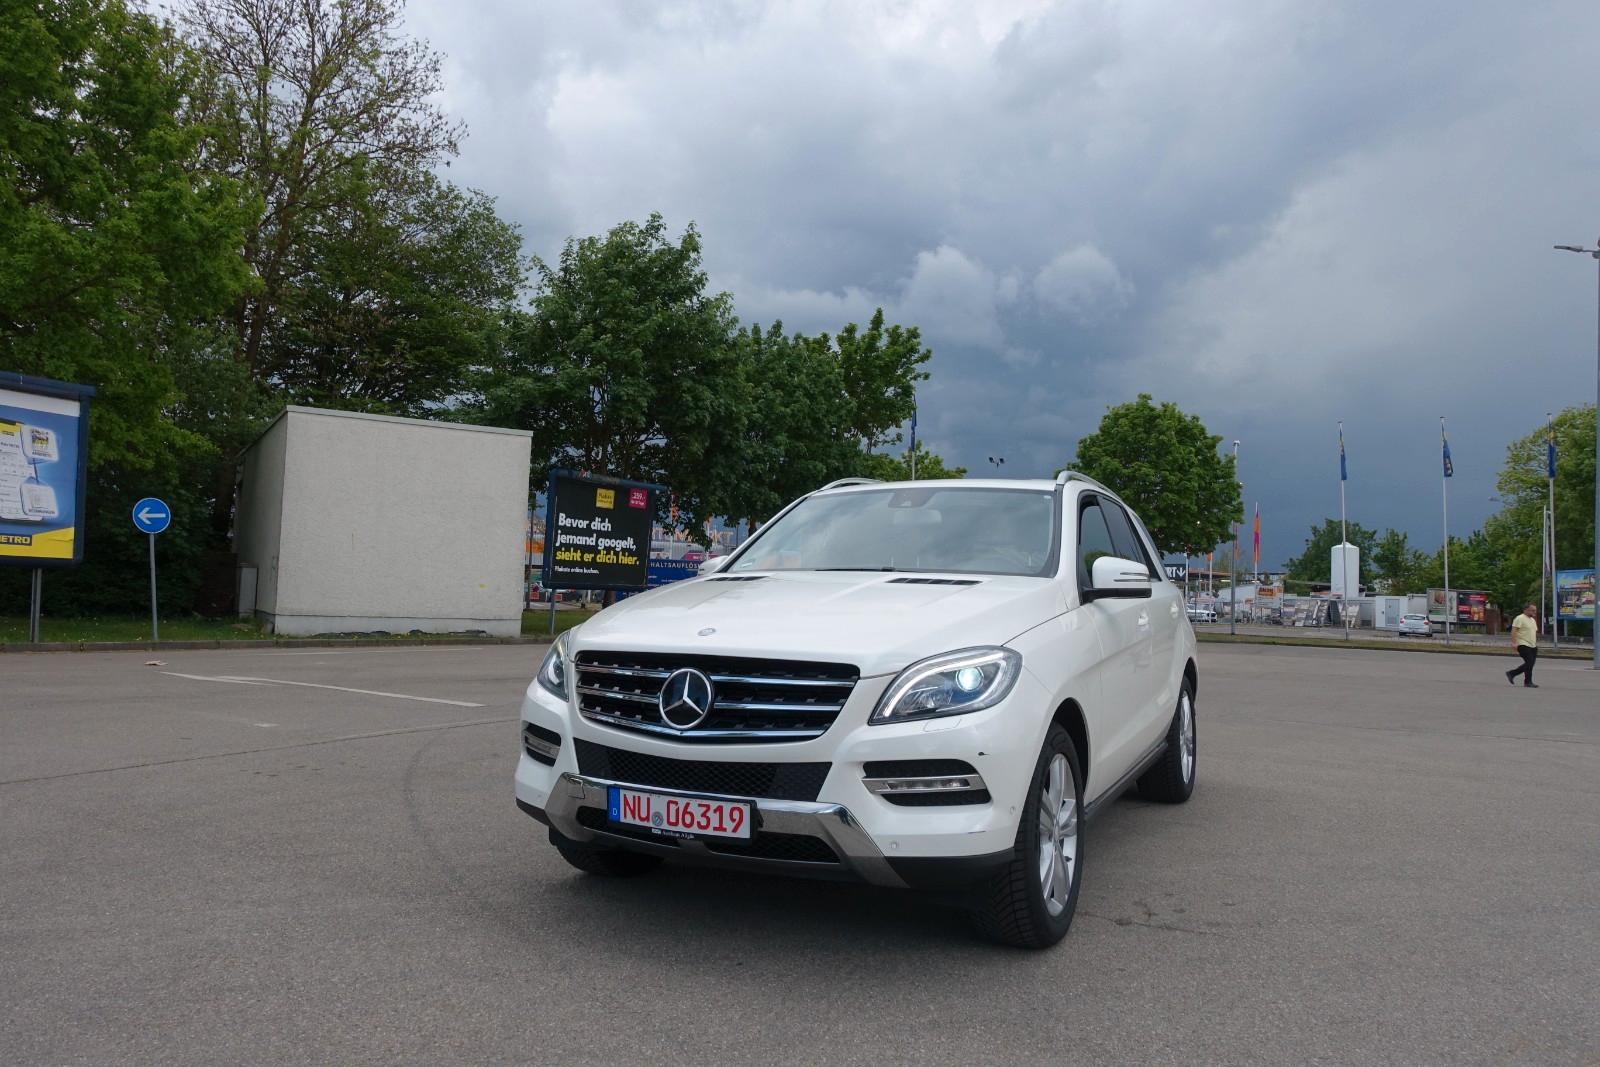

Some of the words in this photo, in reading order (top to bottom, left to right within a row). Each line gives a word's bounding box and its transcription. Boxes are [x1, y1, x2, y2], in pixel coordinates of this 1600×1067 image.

[558, 513, 590, 529] Bevor
[590, 517, 612, 532] dich
[555, 529, 597, 547] jemand
[597, 536, 637, 552] googelt,
[555, 546, 582, 562] sieht
[583, 552, 595, 562] er
[595, 549, 617, 564] dich
[618, 551, 640, 566] hier.
[612, 807, 618, 816] D
[623, 793, 651, 823] NU
[666, 799, 744, 833] 06319
